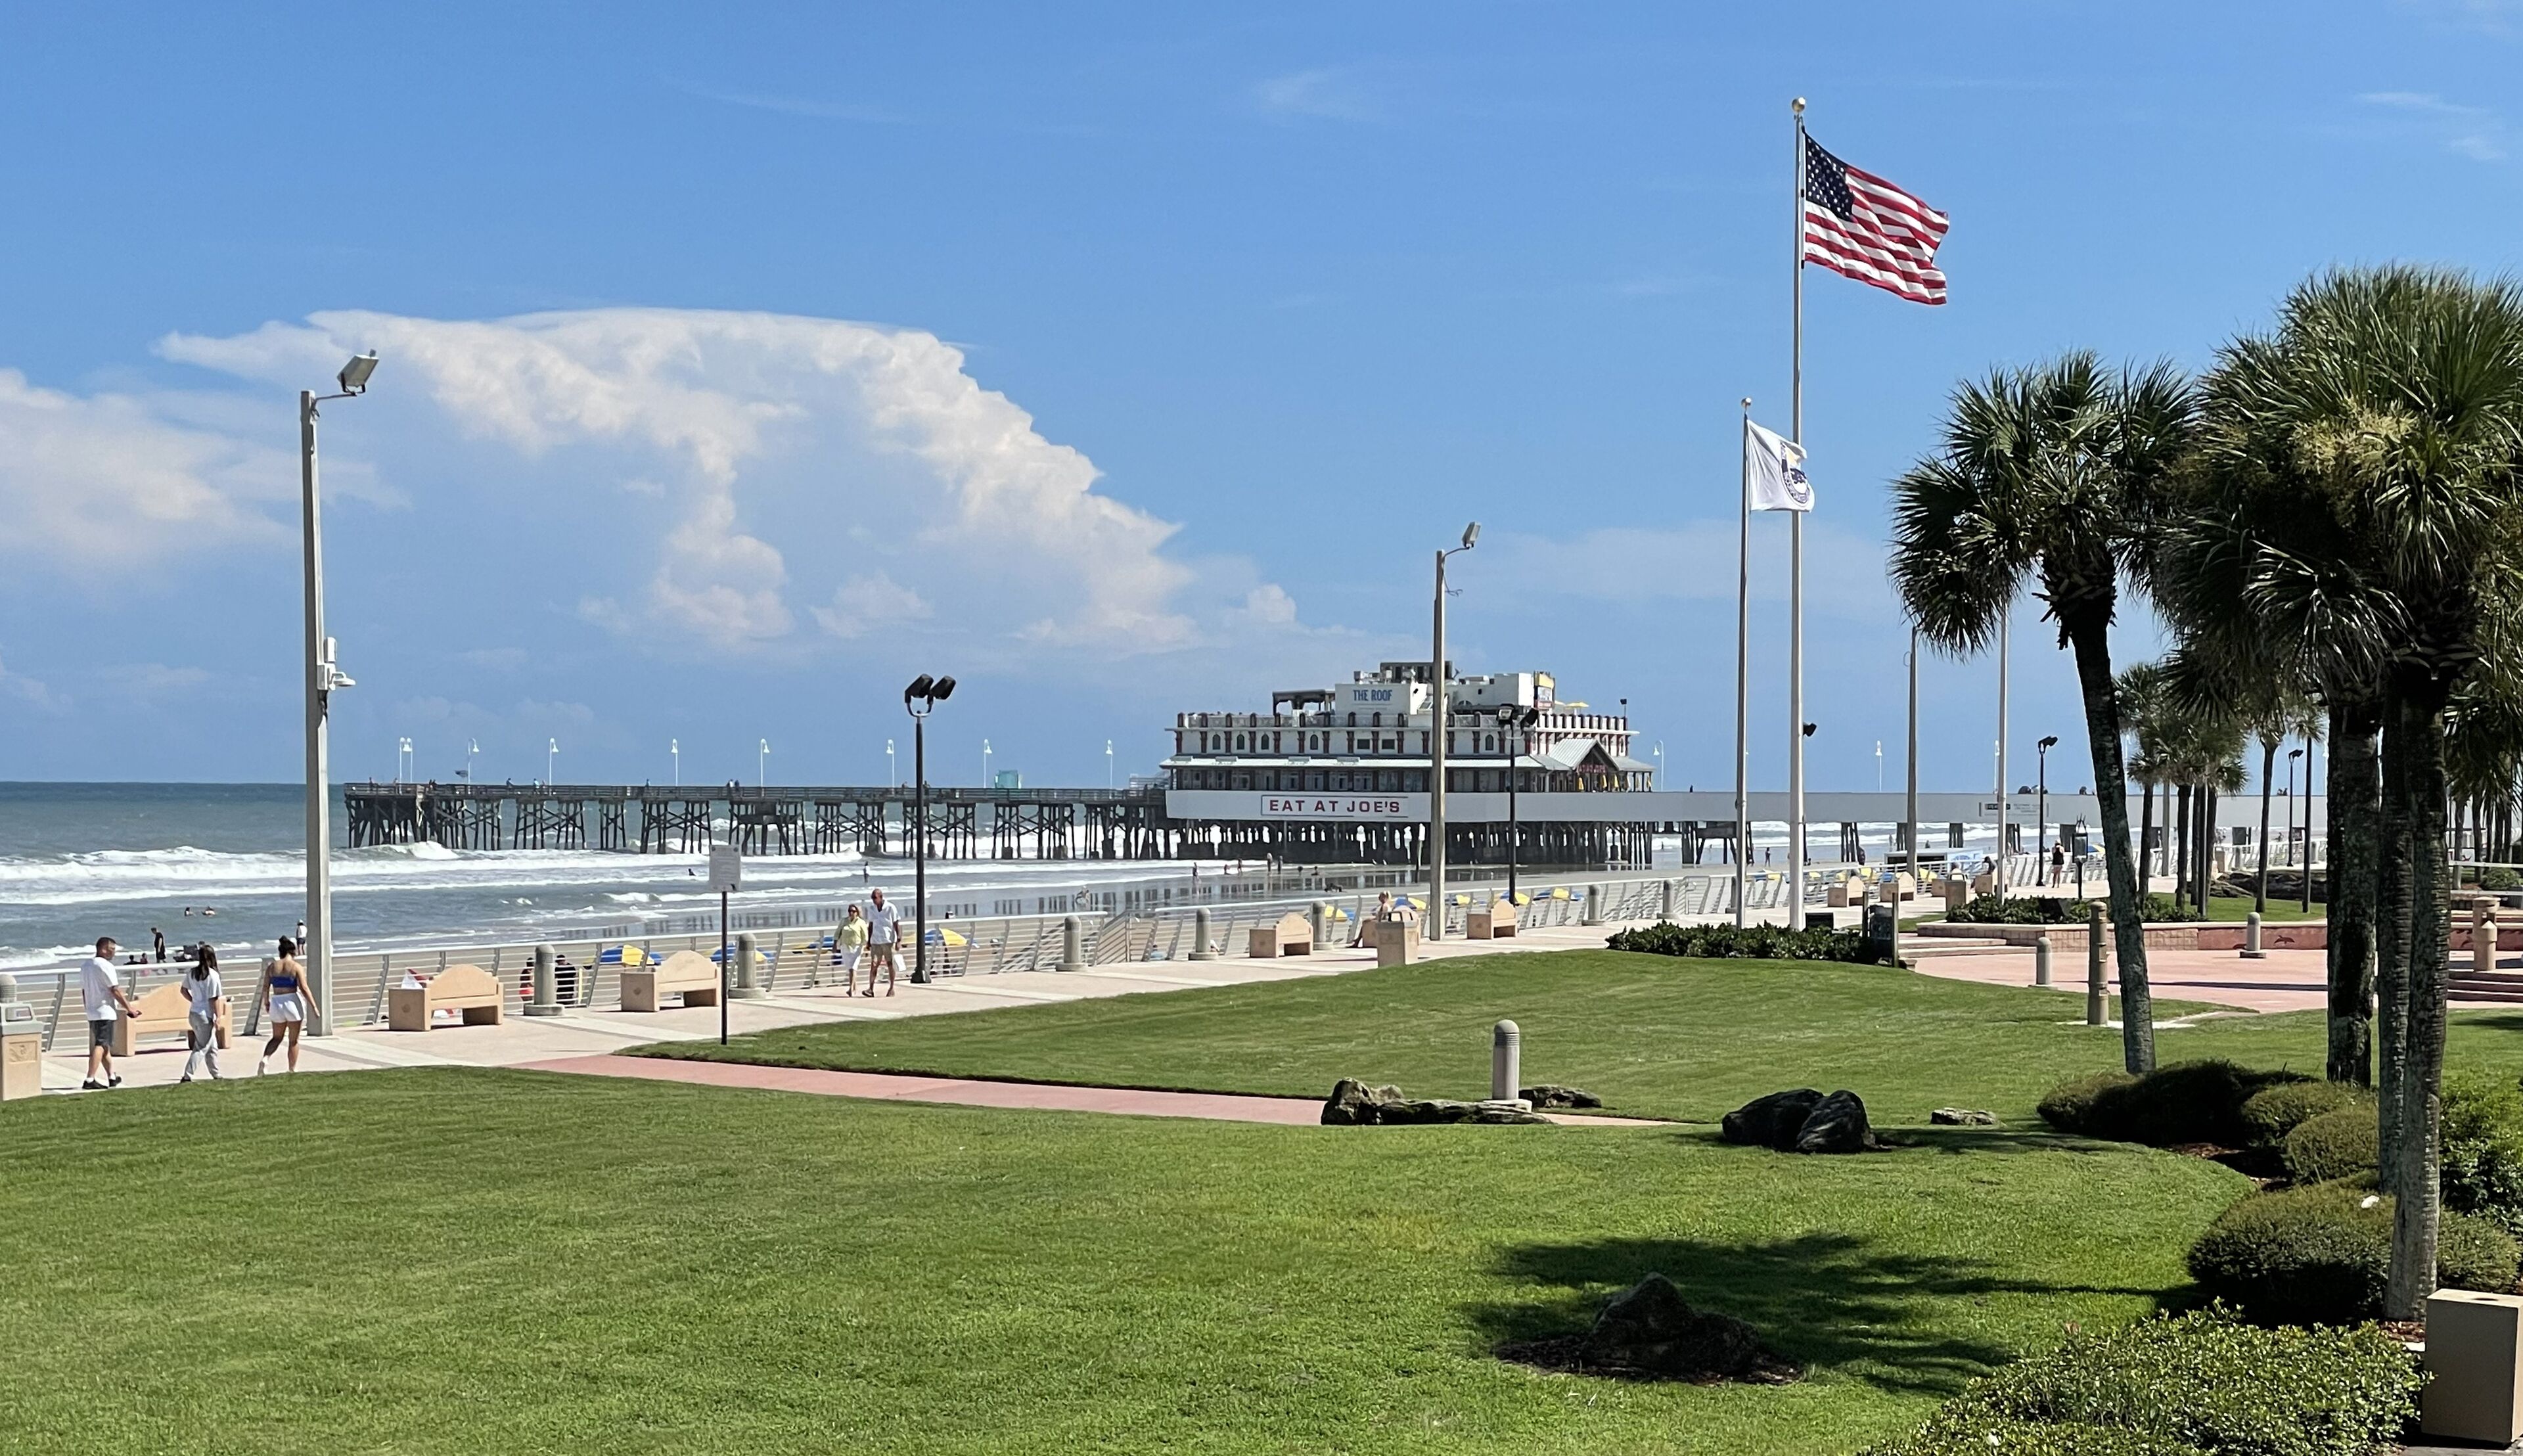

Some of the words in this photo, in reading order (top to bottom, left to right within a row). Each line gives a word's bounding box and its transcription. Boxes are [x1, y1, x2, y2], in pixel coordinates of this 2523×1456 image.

[1353, 689, 1369, 702] THE
[1371, 689, 1392, 702] ROOF
[1269, 800, 1305, 811] EAT
[1314, 800, 1338, 812] AT
[1347, 801, 1399, 813] JOE'S
